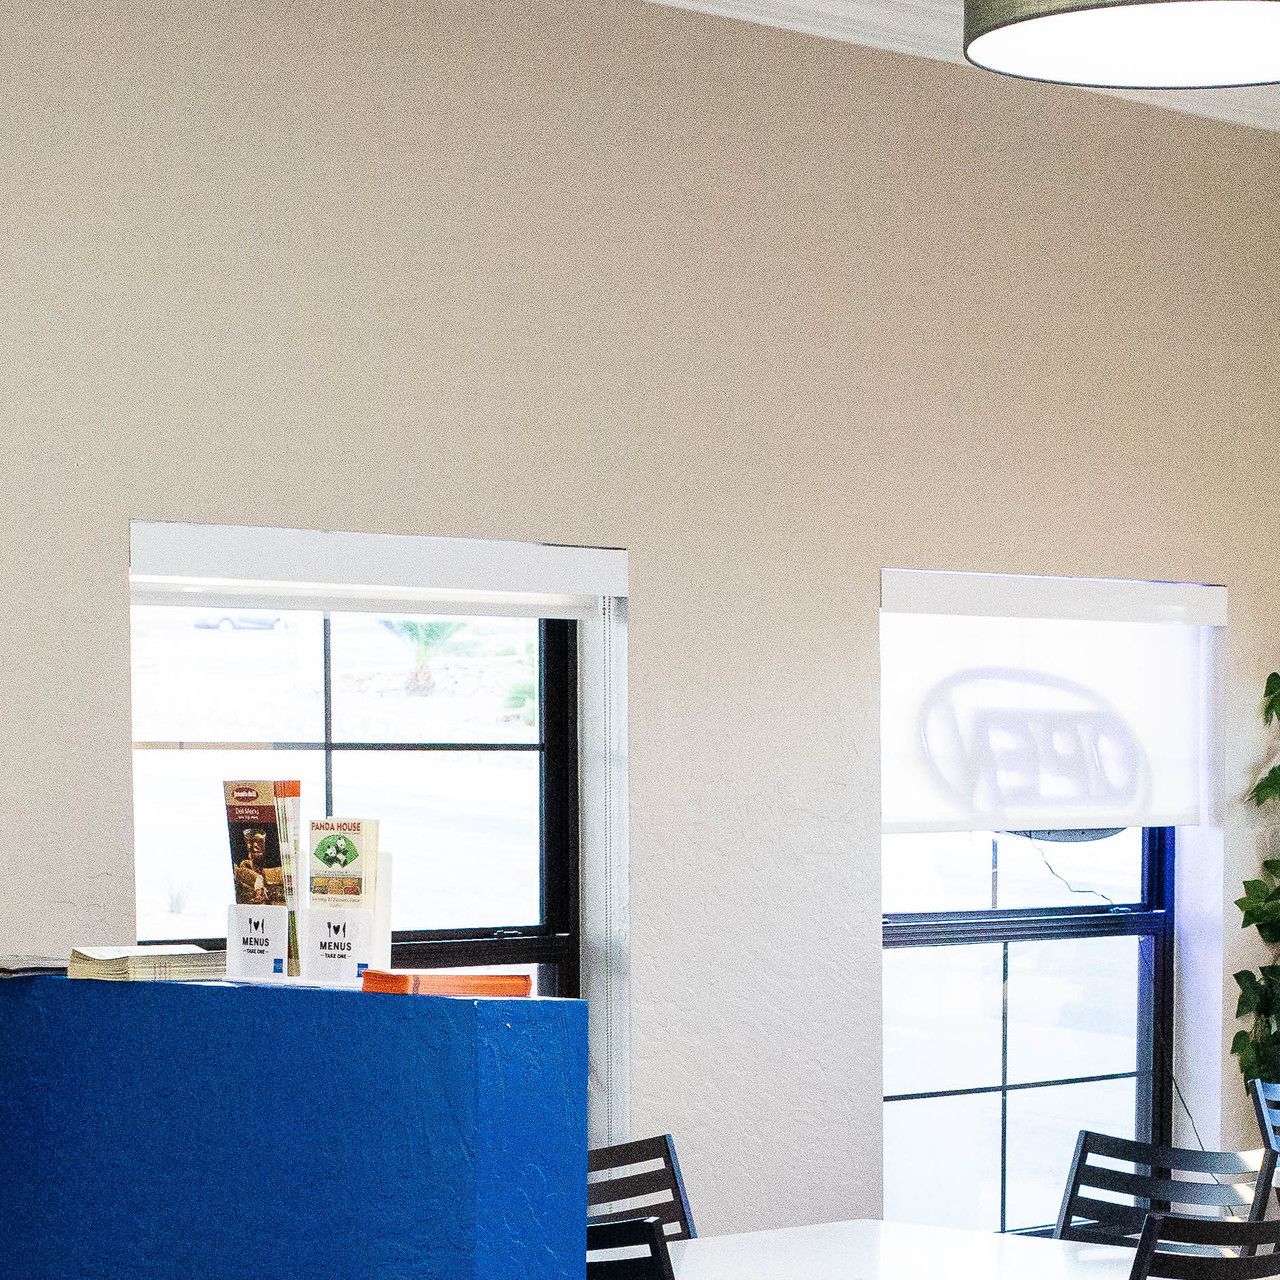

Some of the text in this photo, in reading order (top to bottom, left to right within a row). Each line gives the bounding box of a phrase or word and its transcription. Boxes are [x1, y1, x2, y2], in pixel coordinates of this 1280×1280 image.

[311, 822, 361, 832] PANDA HOUSE
[242, 937, 270, 947] MENUS
[319, 941, 352, 951] MENUS
